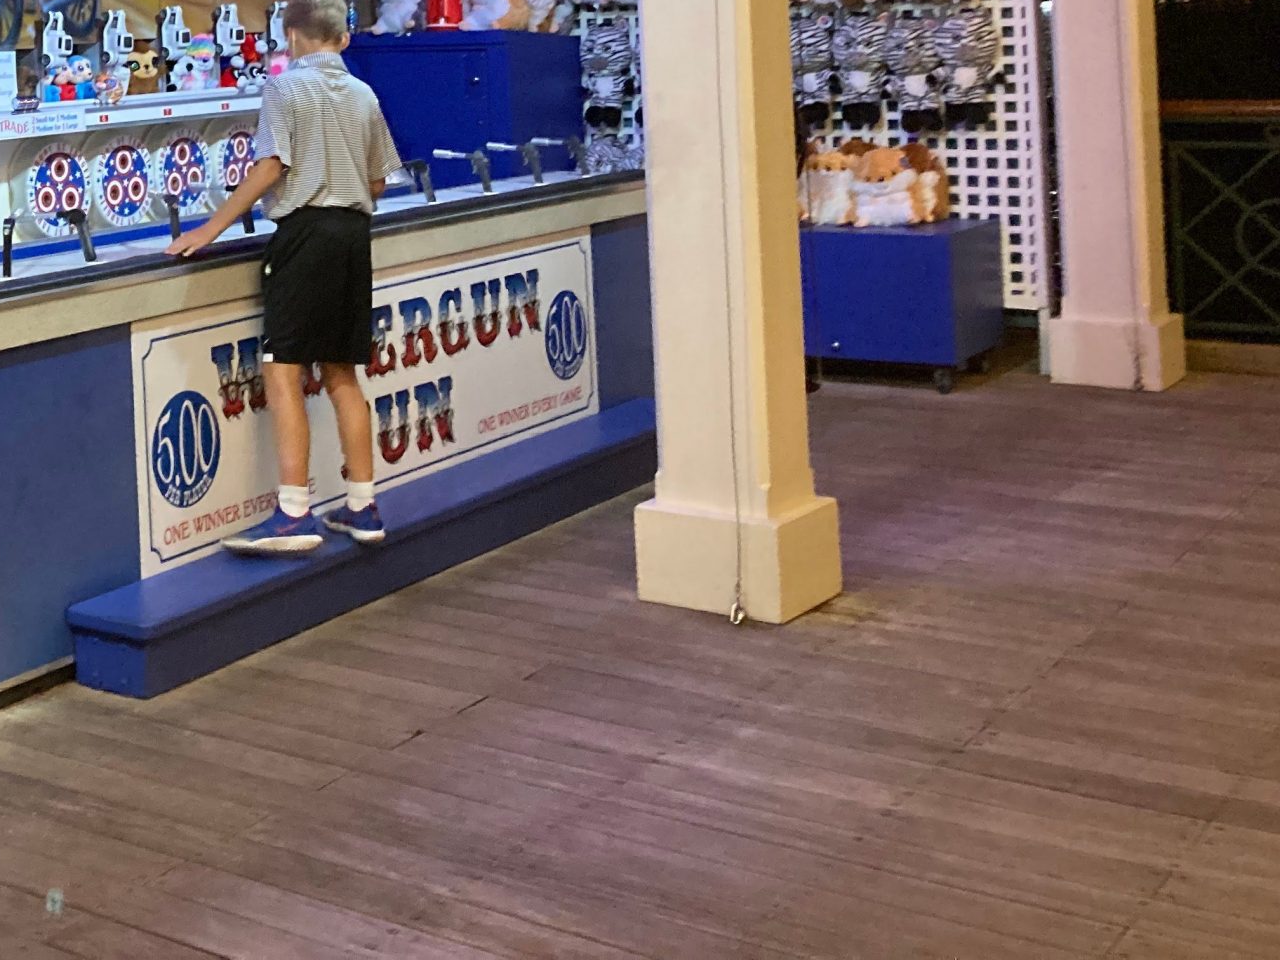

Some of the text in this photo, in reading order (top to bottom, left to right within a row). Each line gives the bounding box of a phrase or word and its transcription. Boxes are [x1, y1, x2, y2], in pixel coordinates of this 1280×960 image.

[0, 119, 30, 134] TRADE
[211, 268, 542, 421] WERGUN
[549, 296, 586, 362] 5.00
[478, 386, 583, 434] ONE WINNER EVERY GAME
[157, 399, 217, 487] 5.00
[163, 521, 191, 546] ONE
[193, 504, 241, 535] WINNER
